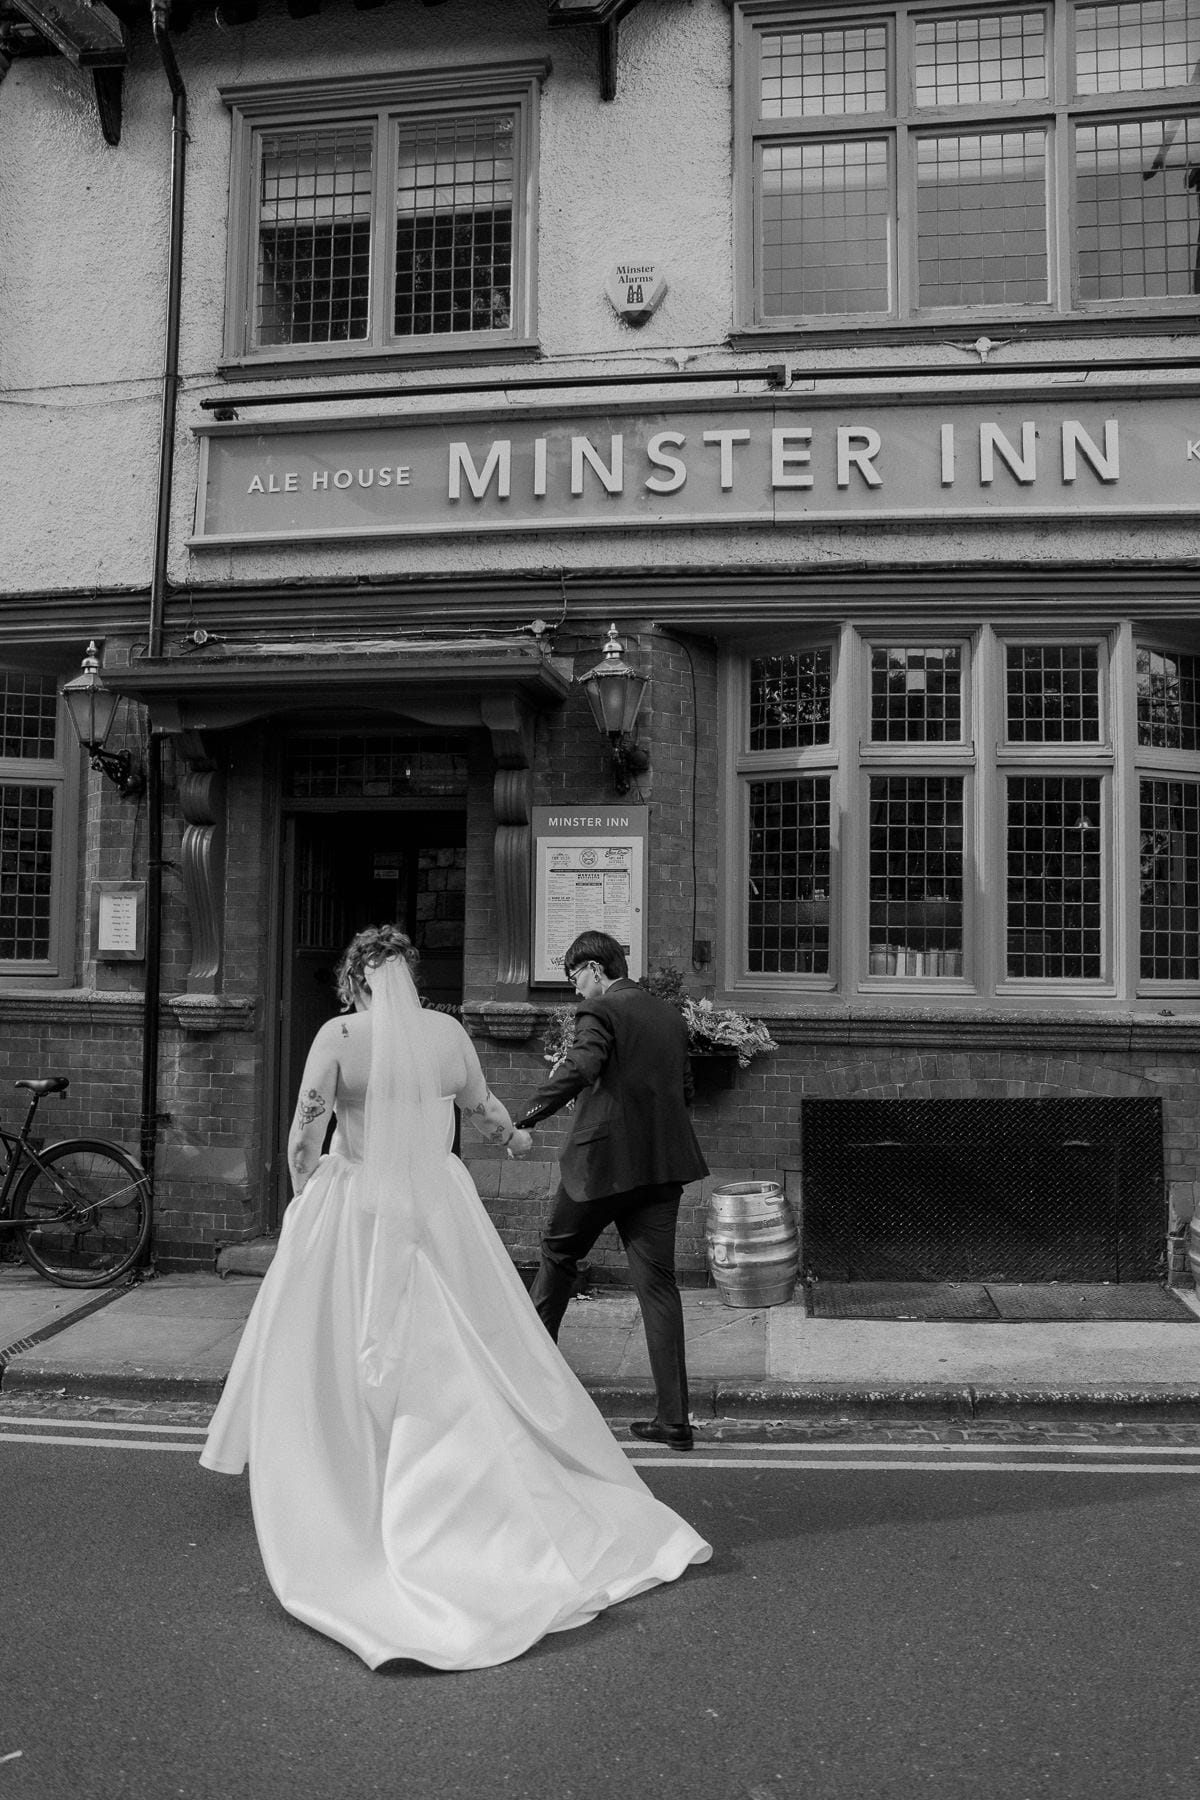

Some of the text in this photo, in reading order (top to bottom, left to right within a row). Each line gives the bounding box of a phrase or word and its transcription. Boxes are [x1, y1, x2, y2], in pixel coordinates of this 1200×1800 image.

[616, 265, 655, 275] Minster
[618, 275, 653, 284] Alarms
[448, 419, 1120, 499] MINSTER INN
[247, 466, 410, 494] ALE HOUSE
[548, 817, 629, 827] MINSTER INN
